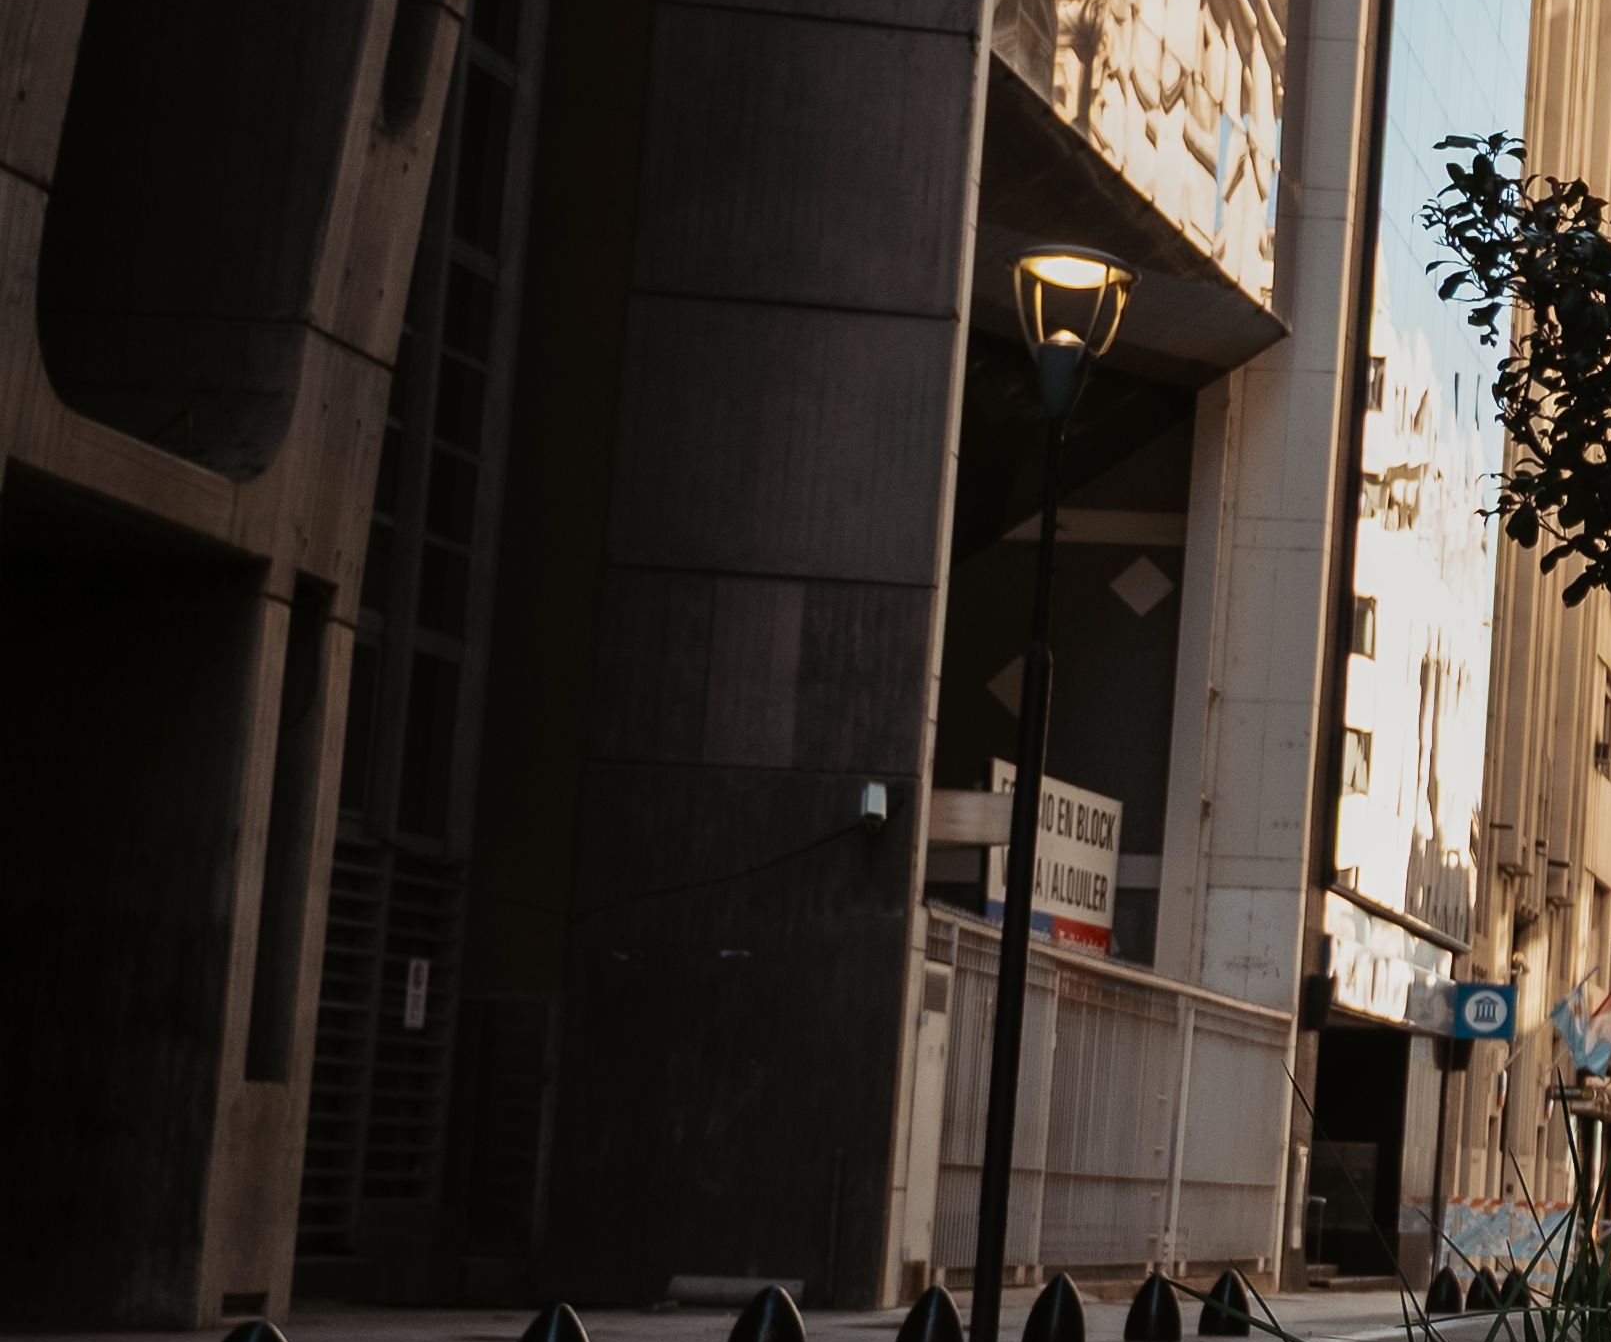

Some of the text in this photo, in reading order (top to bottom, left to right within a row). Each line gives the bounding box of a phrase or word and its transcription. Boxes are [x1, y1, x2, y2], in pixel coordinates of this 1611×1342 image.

[1057, 797, 1074, 839] EN
[1076, 805, 1116, 851] BLOCK
[1051, 863, 1108, 913] ALQUILER
